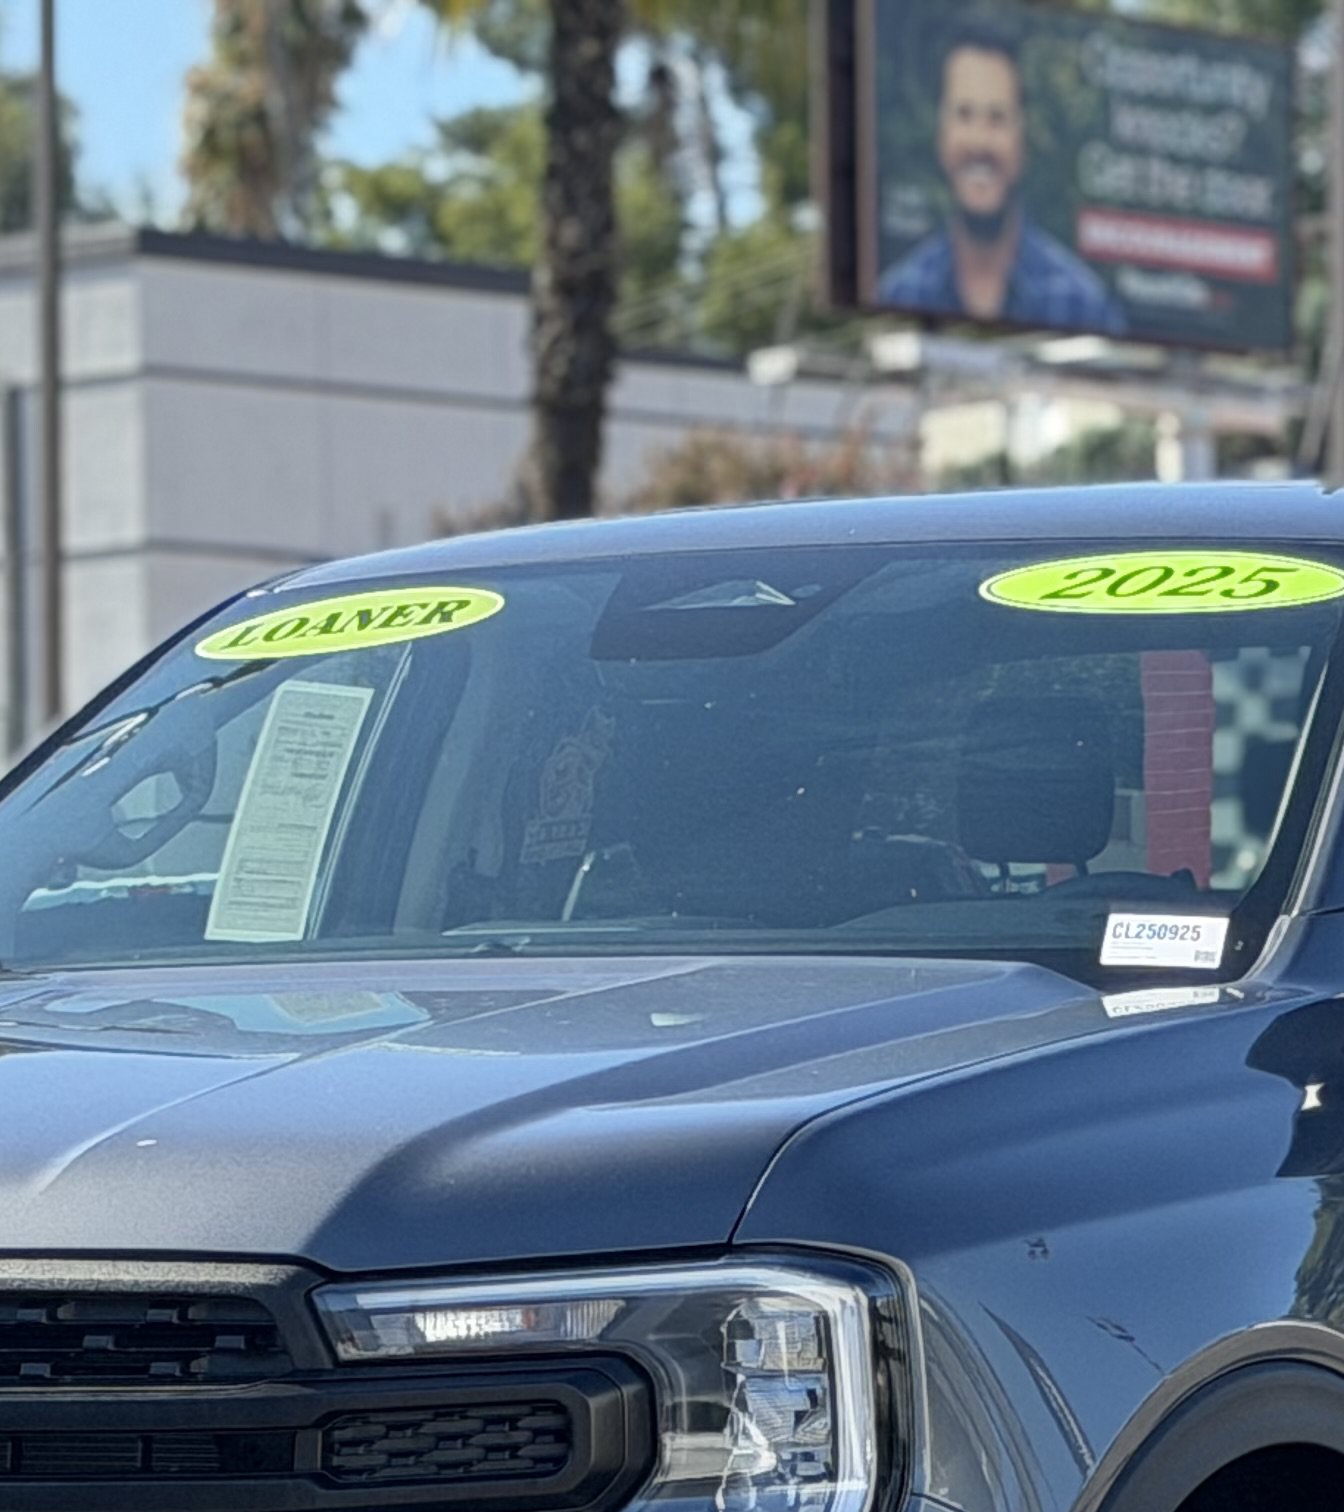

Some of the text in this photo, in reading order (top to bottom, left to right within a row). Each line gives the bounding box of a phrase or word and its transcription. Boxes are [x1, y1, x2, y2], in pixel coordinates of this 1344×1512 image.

[1039, 565, 1300, 600] 2025
[220, 599, 472, 650] LOANER
[1112, 922, 1202, 942] CL250925
